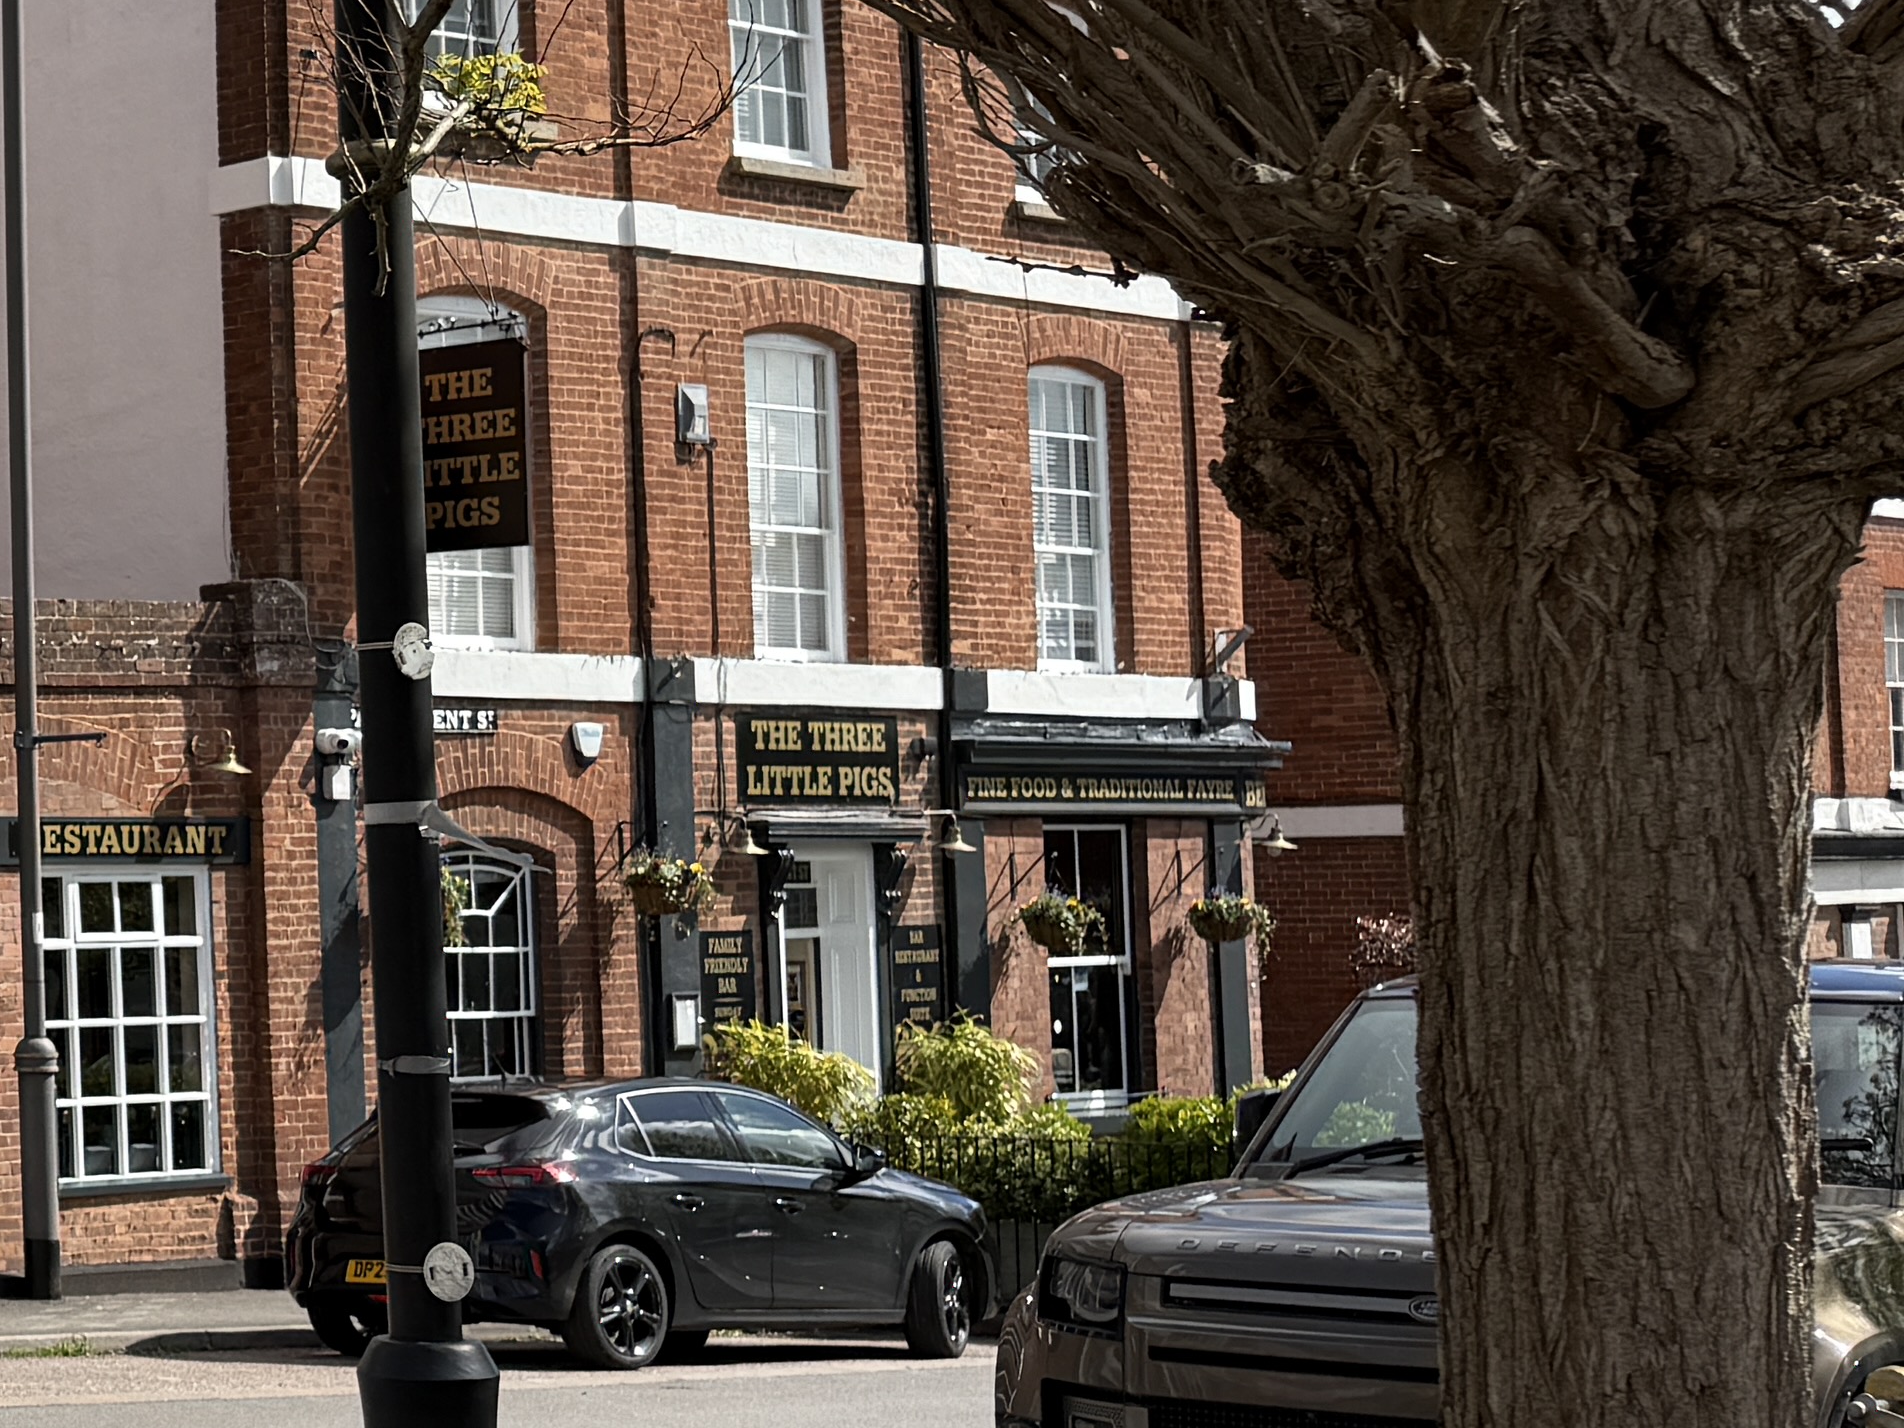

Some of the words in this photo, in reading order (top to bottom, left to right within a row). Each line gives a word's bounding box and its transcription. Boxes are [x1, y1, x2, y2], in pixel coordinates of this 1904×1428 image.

[425, 367, 492, 402] THE
[421, 408, 516, 444] HREE
[423, 452, 520, 487] ITTLE
[425, 496, 501, 530] PIGS
[751, 720, 802, 751] THE
[808, 721, 886, 752] THREE
[746, 765, 832, 796] LITTLE
[838, 766, 892, 797] PIGS
[967, 777, 1007, 798] FINE
[1010, 777, 1057, 798] FOOD
[1061, 778, 1074, 798] &
[1077, 778, 1184, 799] TRADITIONAL
[1187, 779, 1234, 800] FAYRE
[42, 824, 227, 855] ESTAURANT
[708, 937, 743, 954] FAMILY
[704, 957, 749, 974] FRIENDLY
[718, 977, 737, 993] BAR
[1176, 1237, 1437, 1262] DEFENDE
[352, 1260, 386, 1279] DP2
